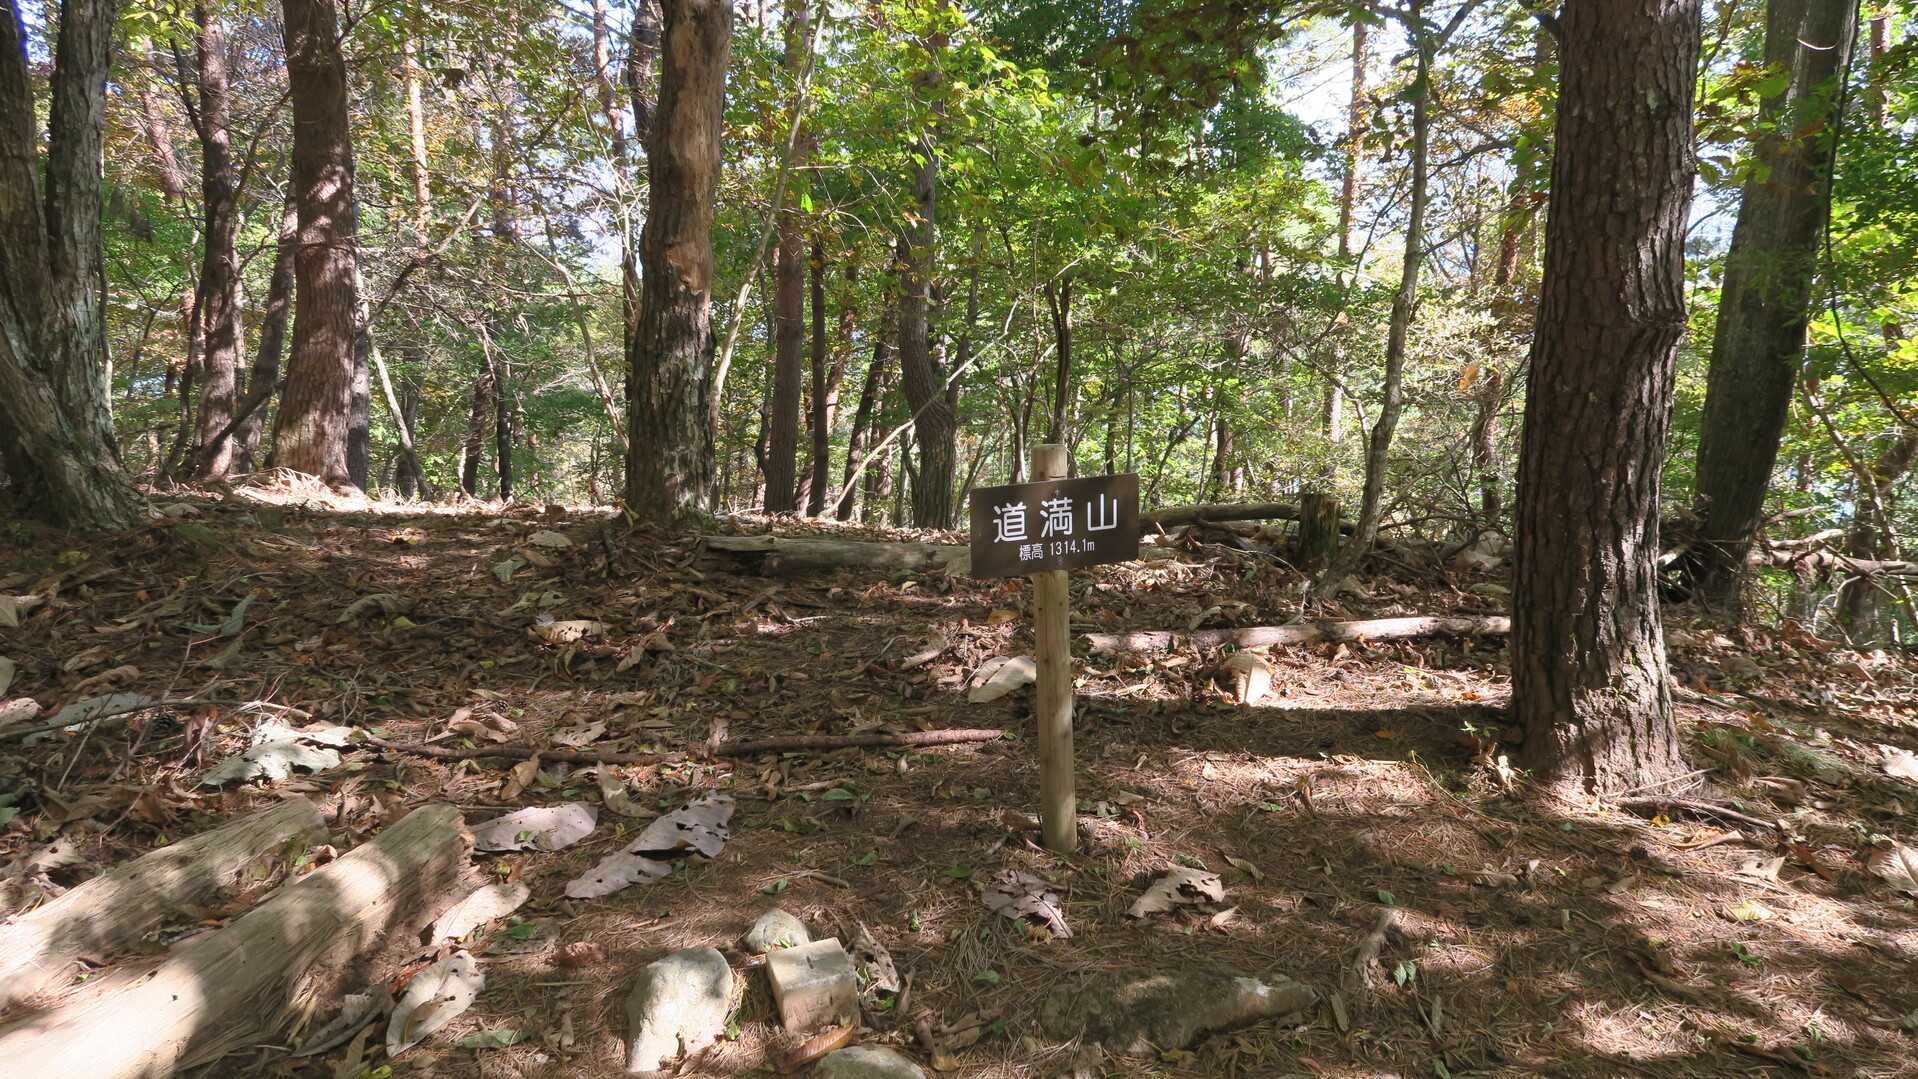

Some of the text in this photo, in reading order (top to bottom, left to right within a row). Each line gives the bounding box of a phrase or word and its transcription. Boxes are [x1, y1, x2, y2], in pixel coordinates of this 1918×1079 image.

[993, 494, 1118, 543] 道満山
[1019, 538, 1095, 561] 標高 1314.1m
